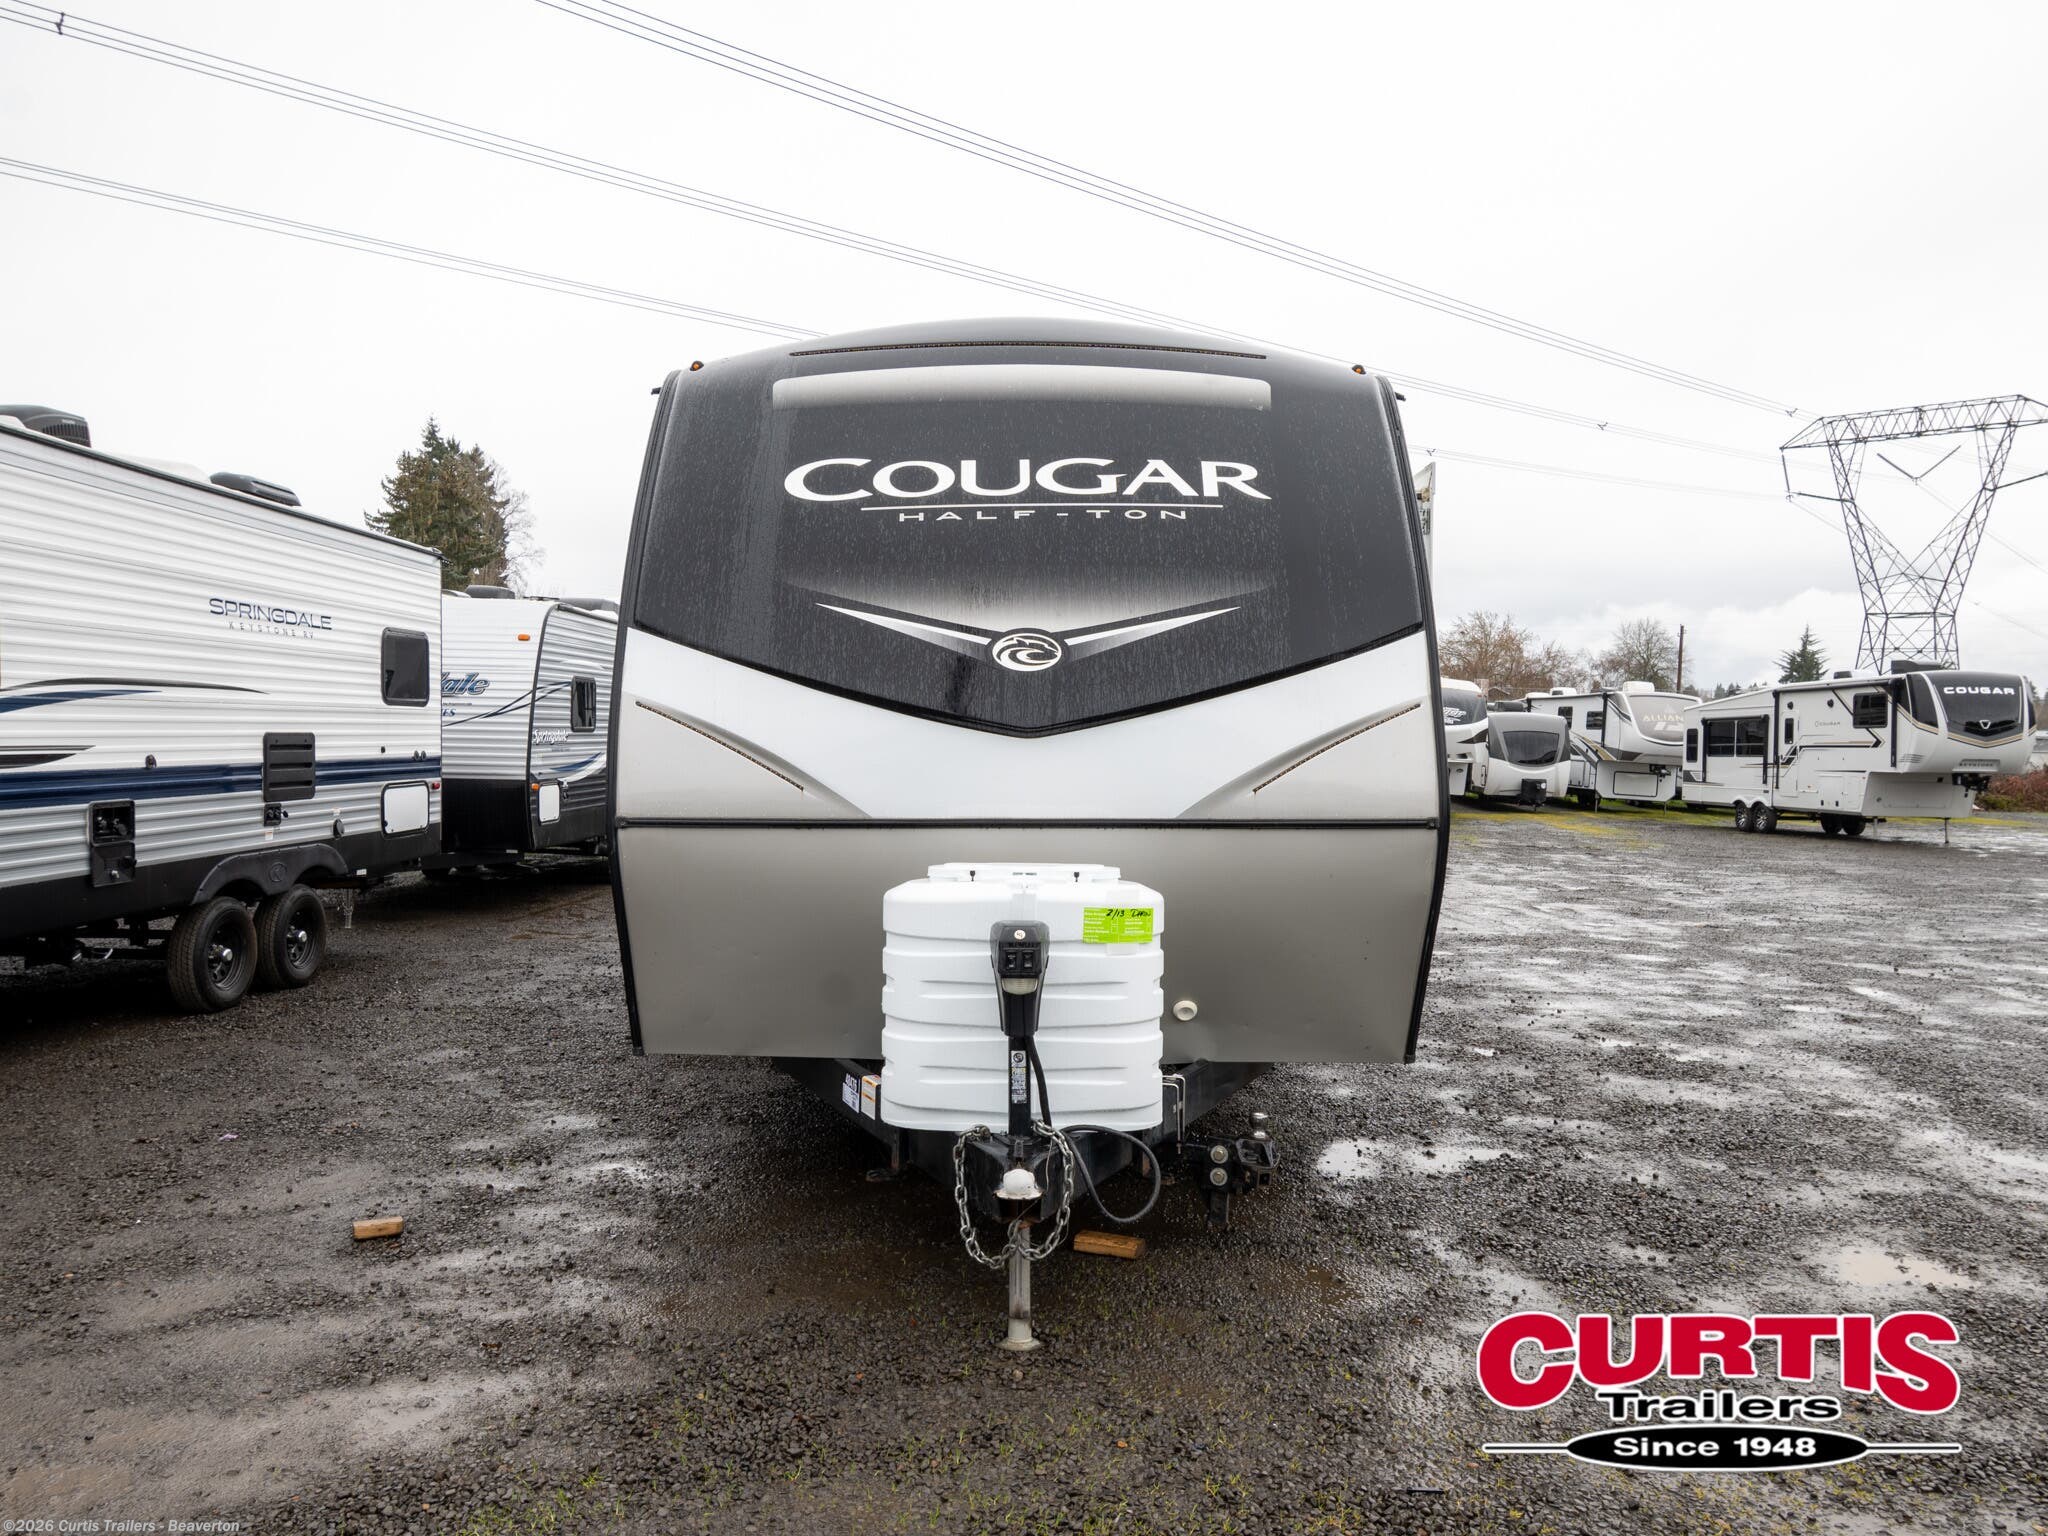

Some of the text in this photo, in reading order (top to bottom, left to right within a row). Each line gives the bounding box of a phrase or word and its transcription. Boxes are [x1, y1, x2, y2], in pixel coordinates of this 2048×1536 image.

[784, 457, 1273, 502] COUGAR
[209, 598, 333, 631] SPRINGDALE
[228, 621, 297, 637] KEYSTONE
[1943, 686, 2015, 695] COUGAR
[1642, 713, 1684, 722] ALLIAN
